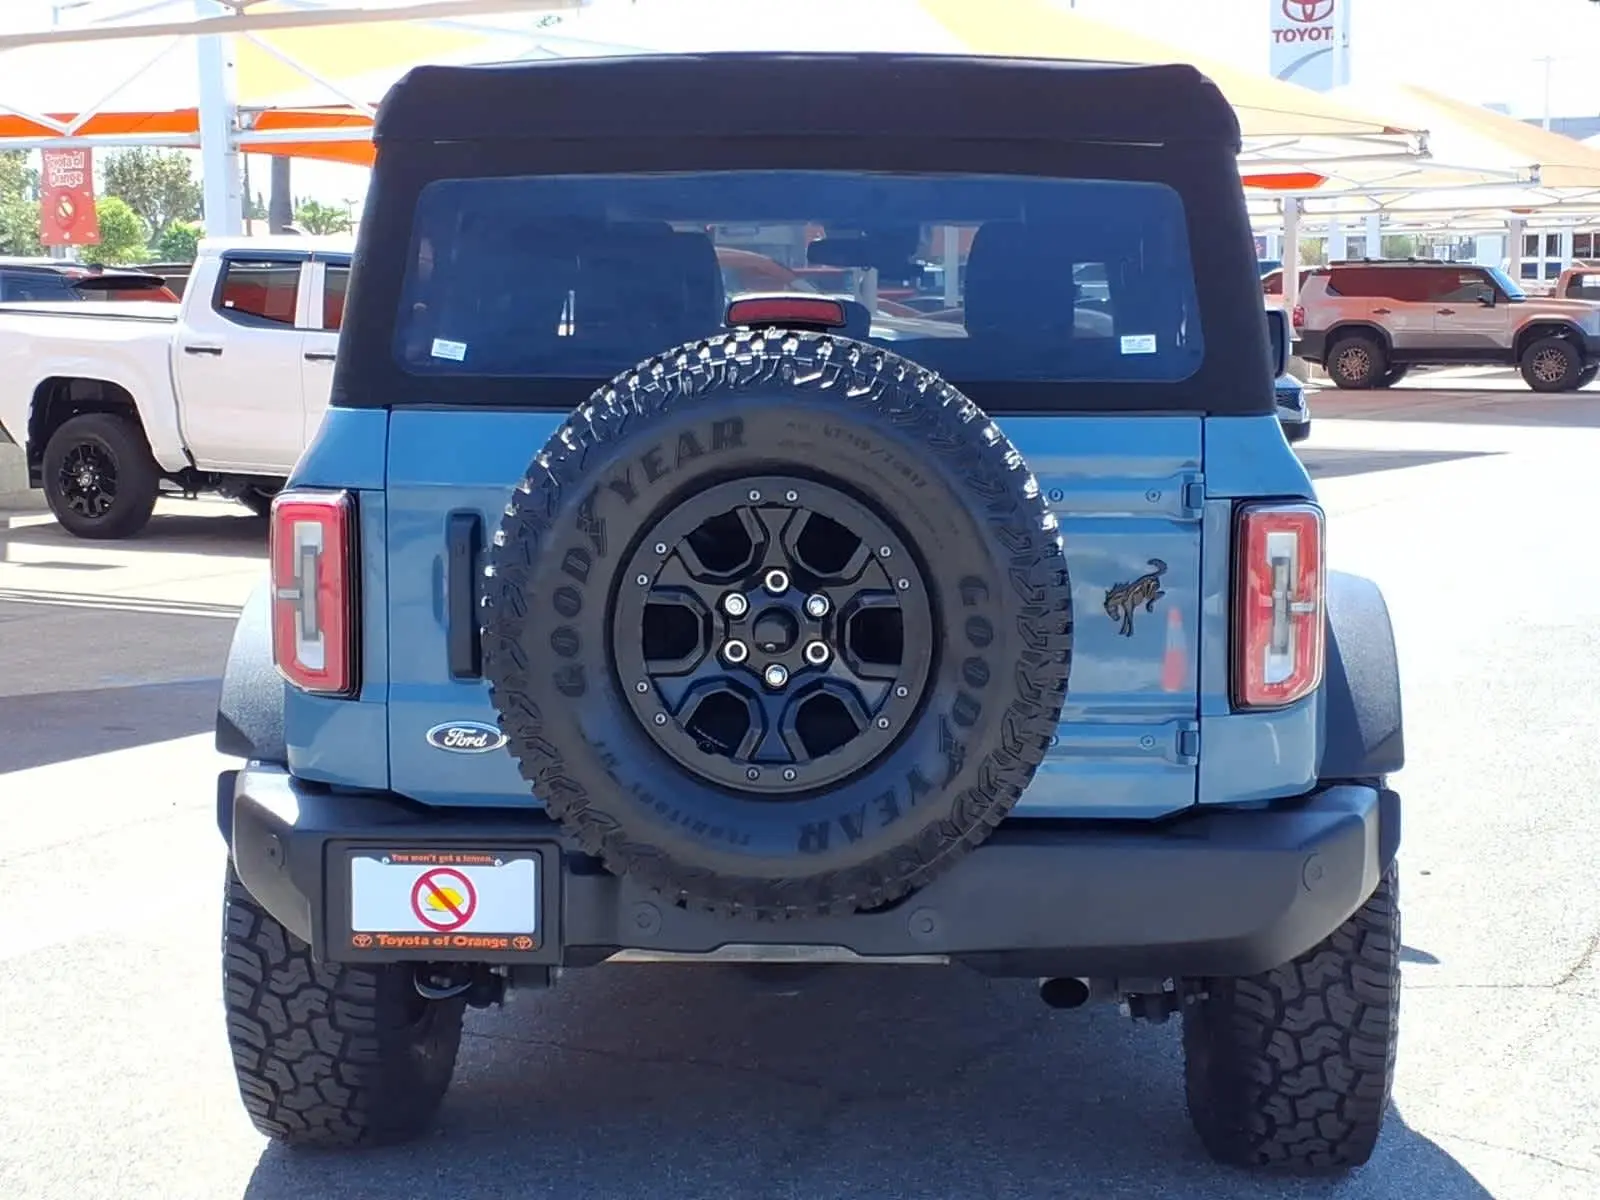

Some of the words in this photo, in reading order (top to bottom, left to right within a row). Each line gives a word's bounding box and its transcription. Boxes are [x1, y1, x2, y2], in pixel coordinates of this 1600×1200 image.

[1272, 26, 1339, 43] TOYOT
[444, 728, 488, 747] Ford
[392, 853, 409, 862] You
[410, 854, 437, 862] won't
[439, 855, 453, 863] get
[376, 934, 430, 948] Toyota
[433, 935, 451, 947] of
[453, 936, 508, 949] Orange
